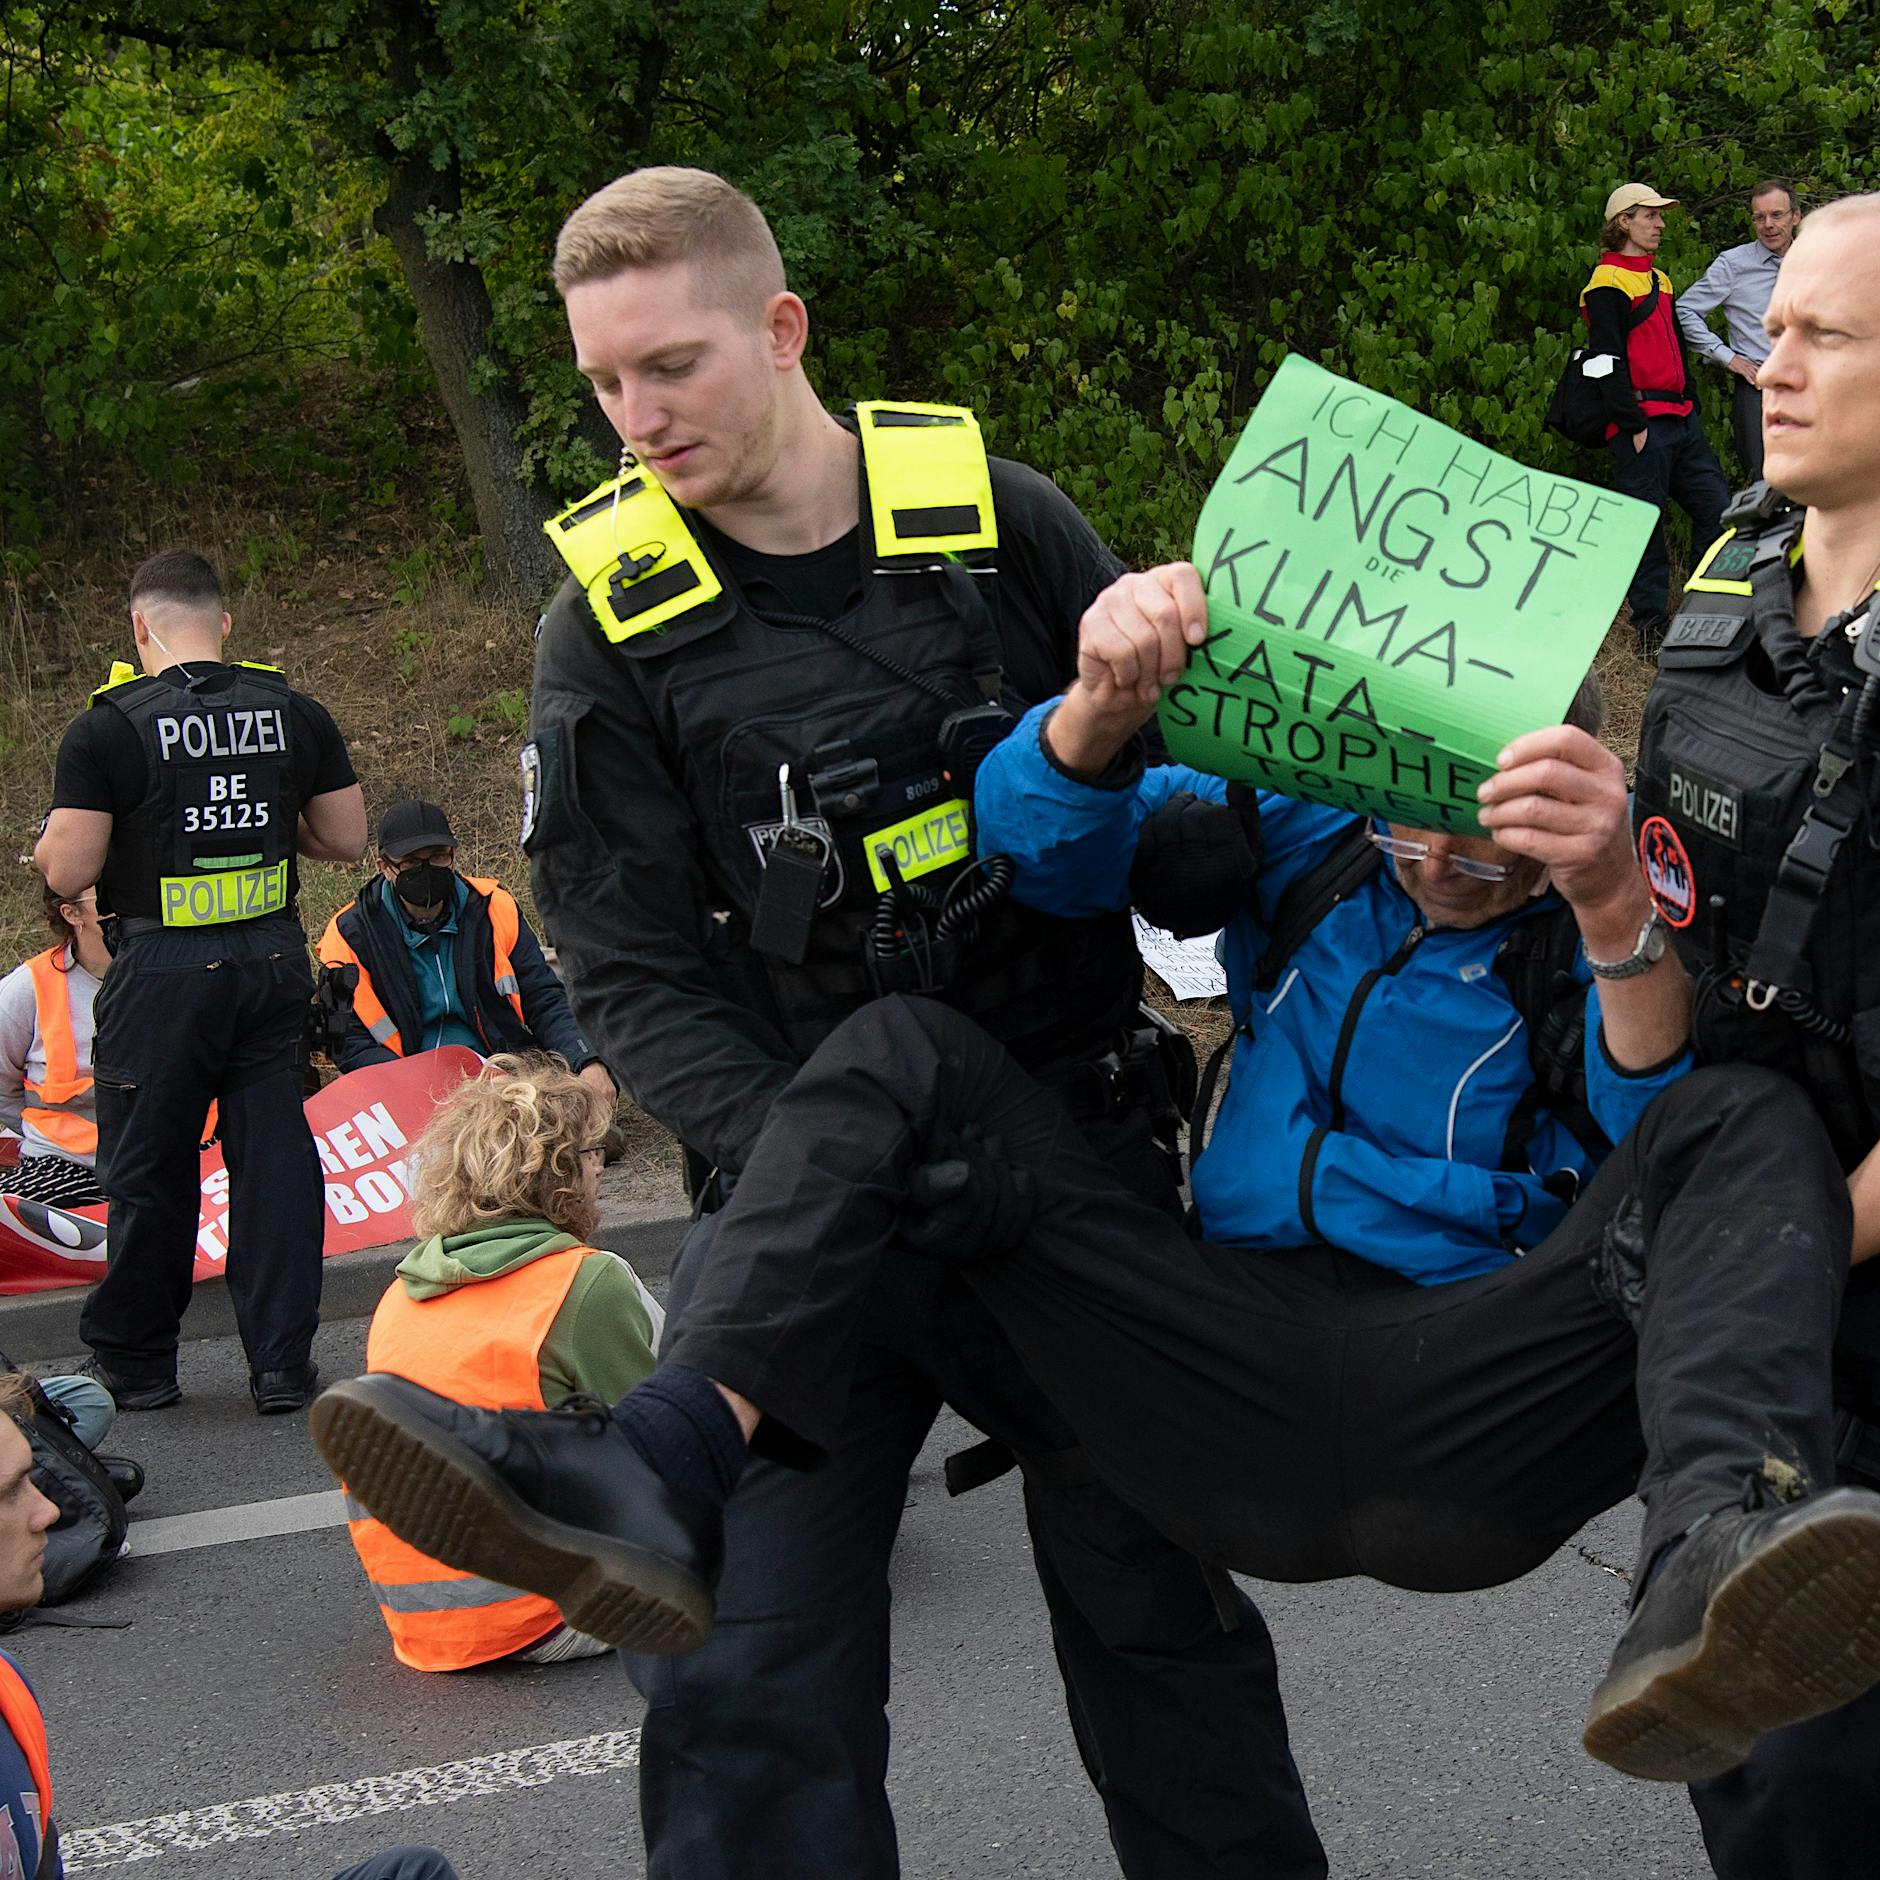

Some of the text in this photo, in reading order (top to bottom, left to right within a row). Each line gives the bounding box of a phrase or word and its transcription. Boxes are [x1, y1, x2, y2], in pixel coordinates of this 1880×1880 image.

[1311, 385, 1623, 548] ICH HABE
[1233, 436, 1577, 611] ANGST
[1364, 556, 1404, 585] DIE
[1206, 528, 1514, 688] KLIMA-
[1673, 618, 1731, 642] BFE
[1186, 628, 1435, 742] KATA-
[157, 709, 287, 761] POLIZEI
[1167, 684, 1481, 805] STROPHE
[209, 774, 247, 802] BE
[905, 777, 939, 800] 8009
[1669, 773, 1737, 840] POLIZEI
[184, 802, 269, 832] 35125
[165, 866, 285, 922] POLIZEI
